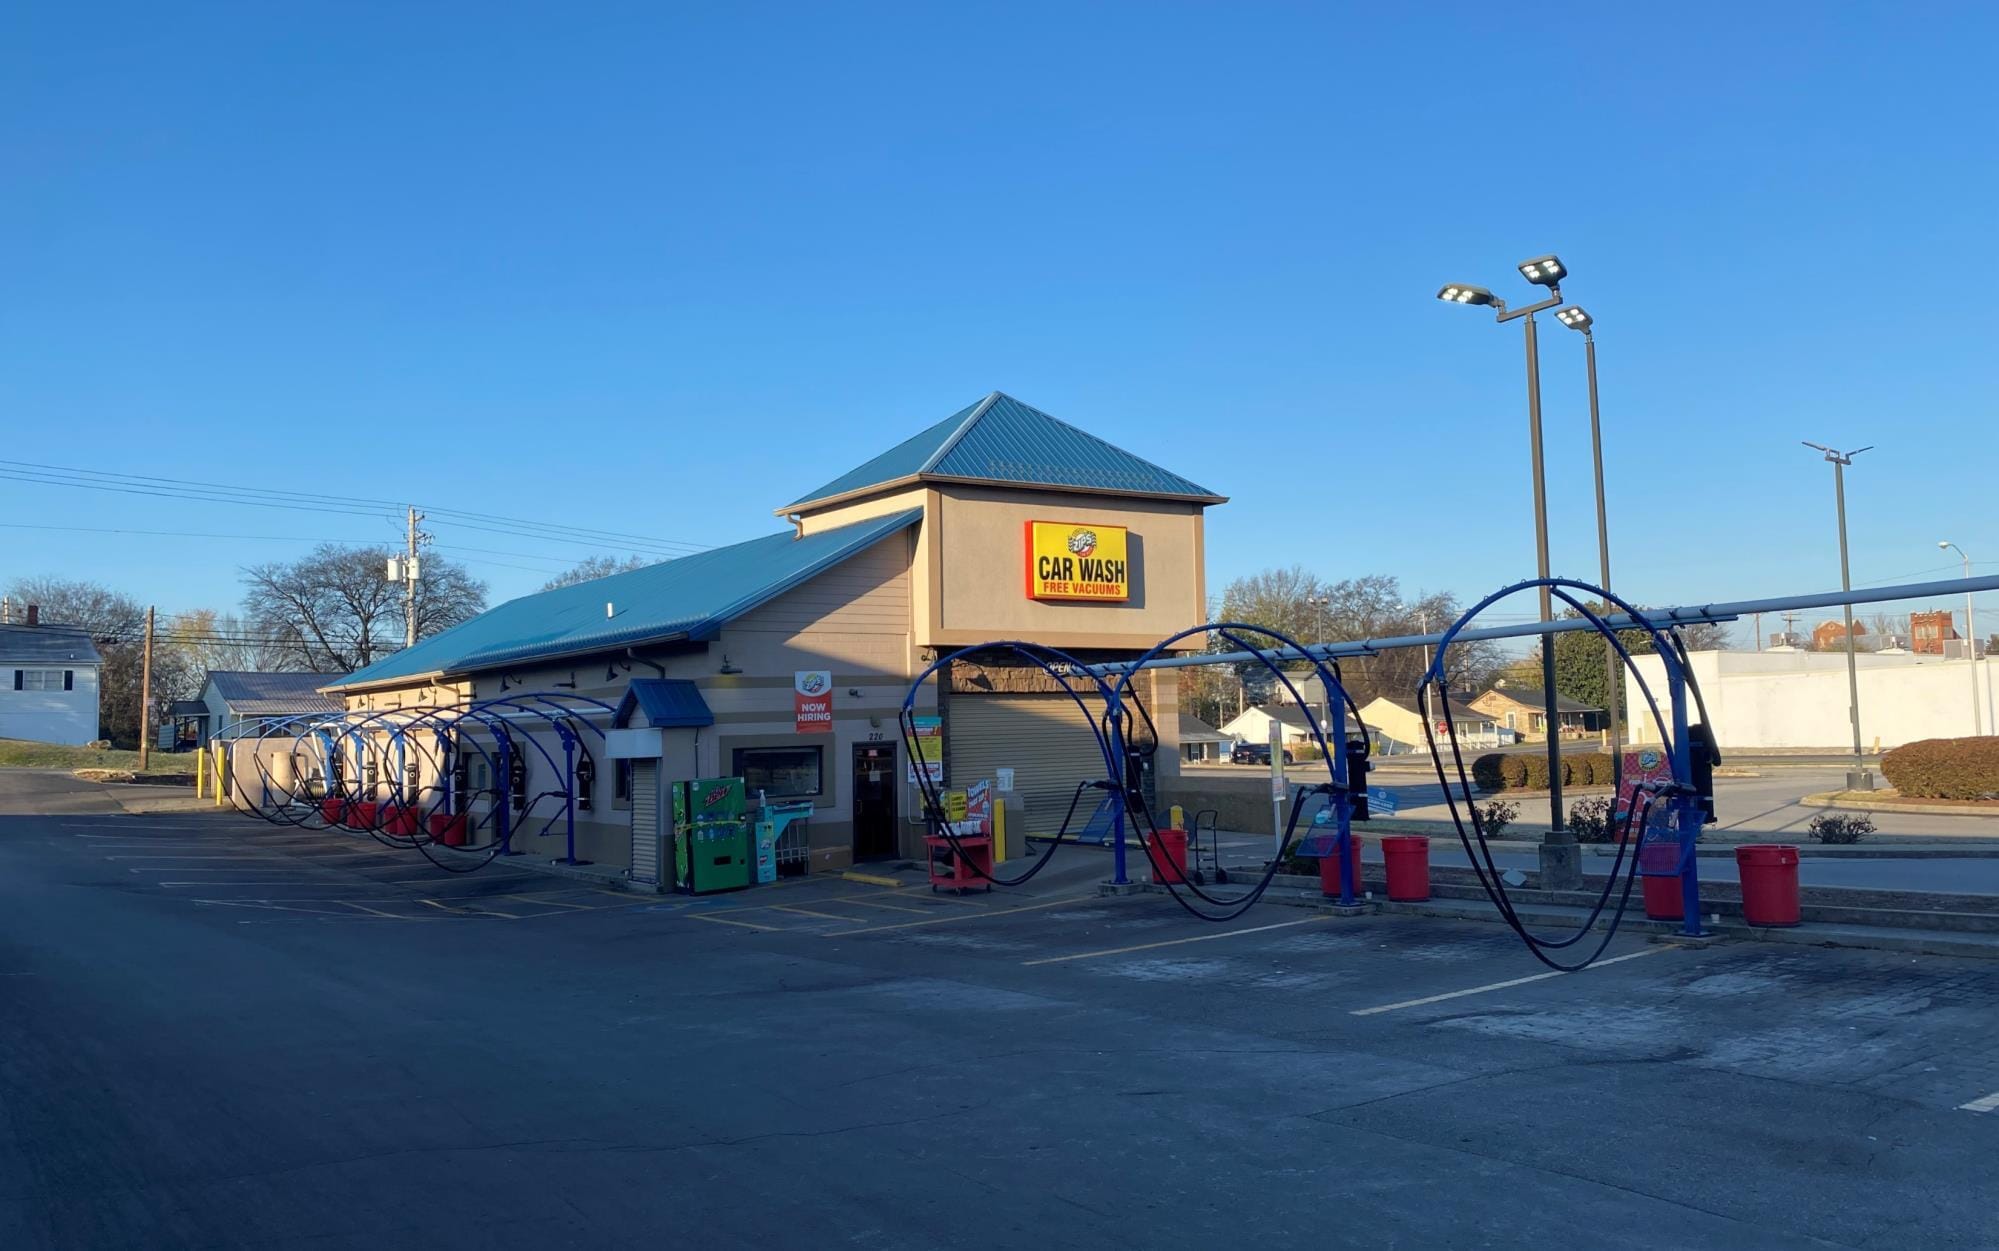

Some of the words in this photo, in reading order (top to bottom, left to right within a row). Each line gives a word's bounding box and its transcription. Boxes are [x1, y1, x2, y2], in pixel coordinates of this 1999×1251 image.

[1073, 534, 1092, 551] ZIPS
[1039, 556, 1073, 581] CAR
[1078, 558, 1124, 583] WASH
[1043, 581, 1069, 593] FREE
[1072, 582, 1121, 595] VACUUMS
[801, 703, 826, 712] NOW
[797, 712, 831, 721] HIRING
